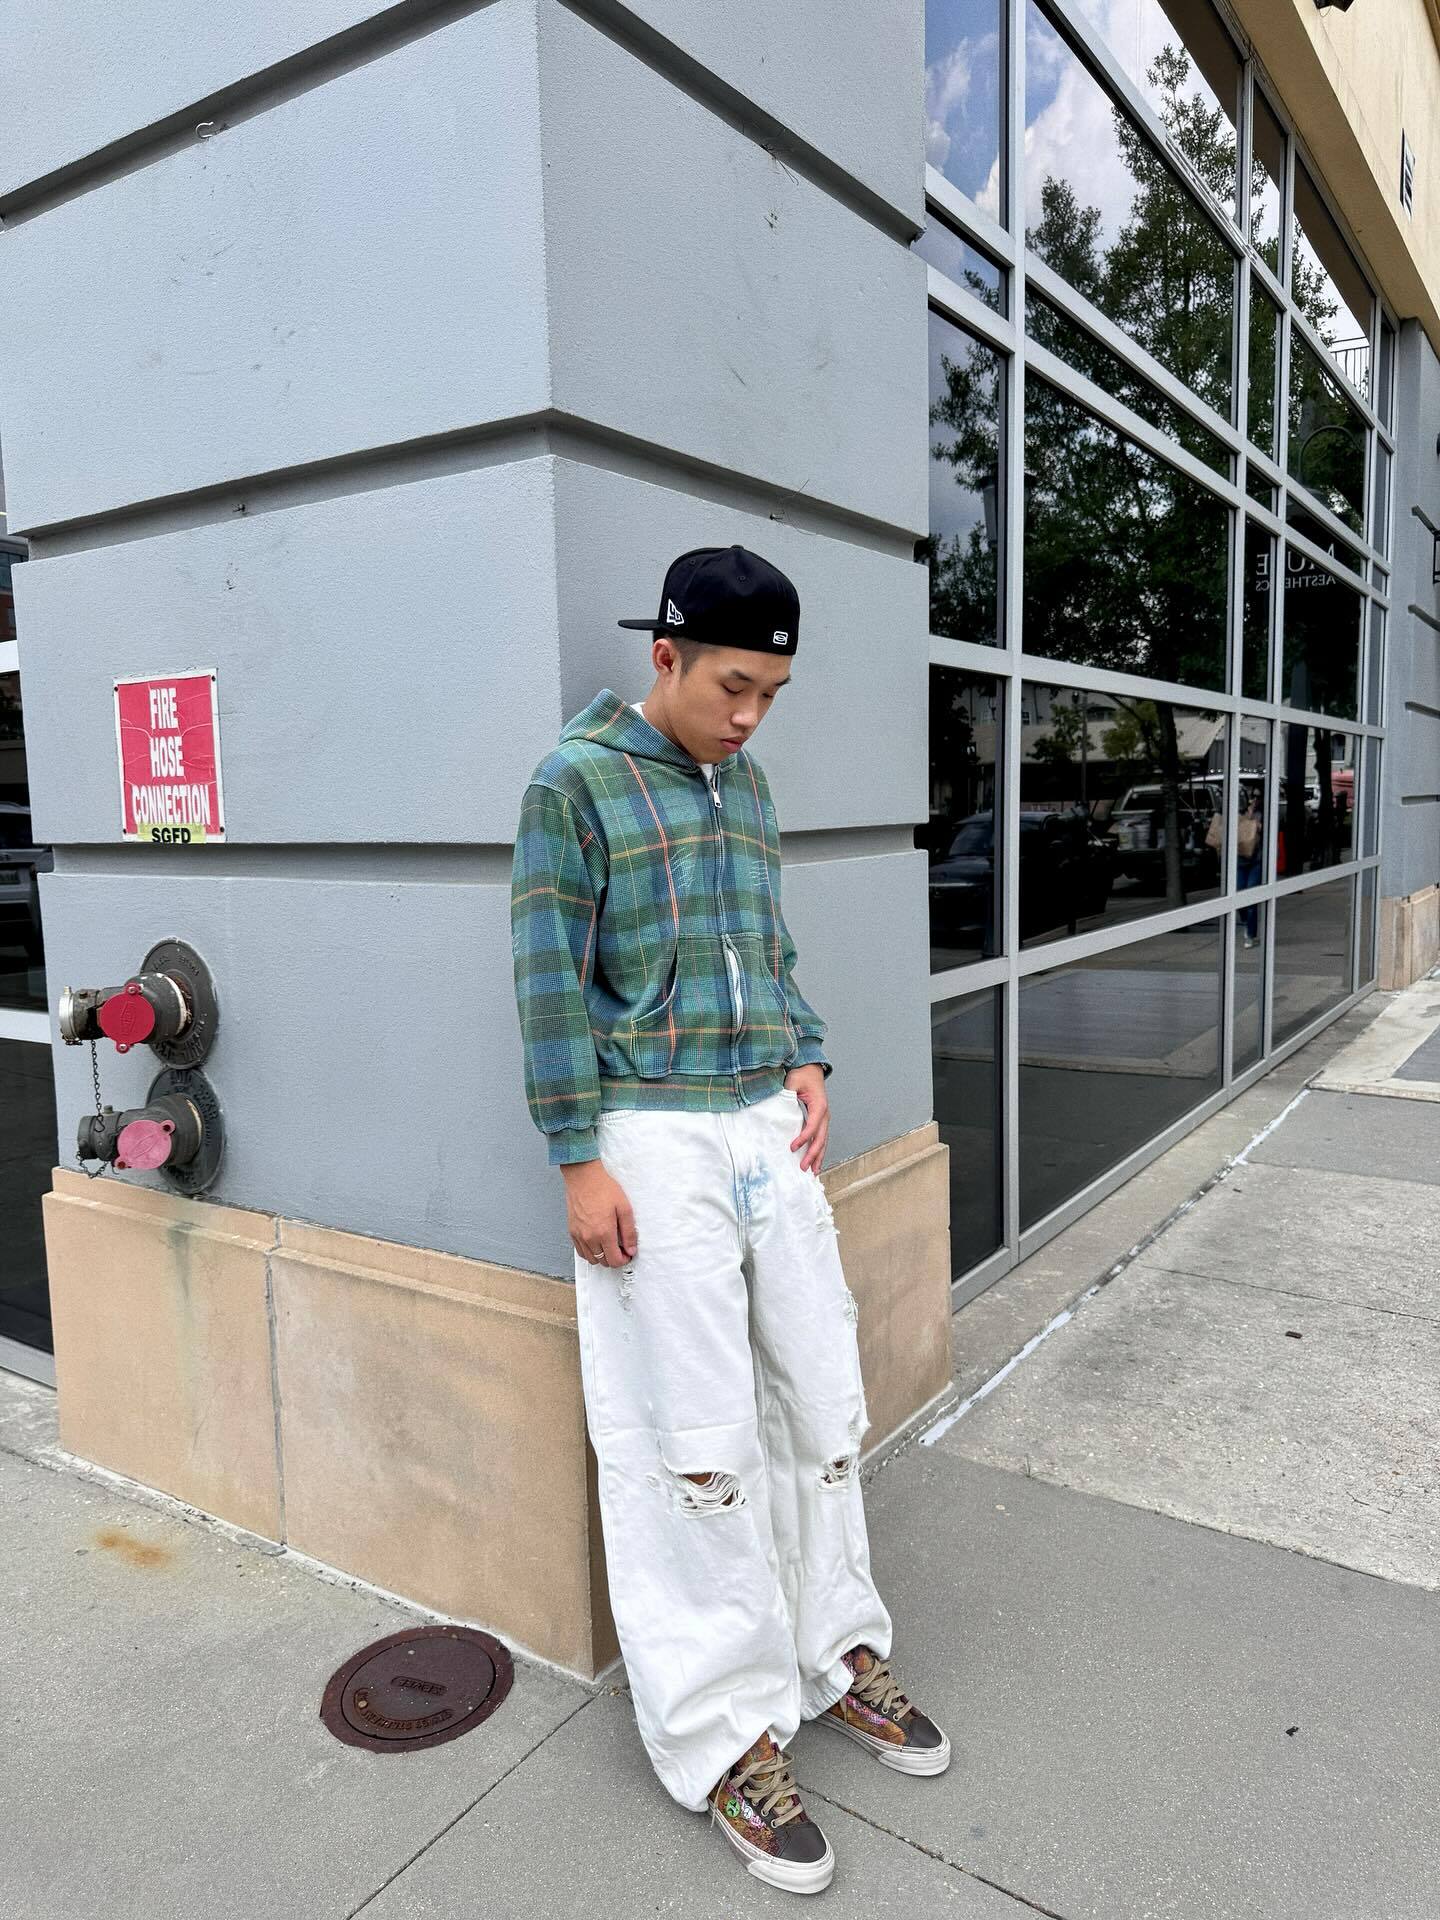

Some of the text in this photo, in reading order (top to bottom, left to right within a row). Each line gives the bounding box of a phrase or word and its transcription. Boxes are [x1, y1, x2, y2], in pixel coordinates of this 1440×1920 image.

[150, 687, 179, 729] FIRE
[150, 736, 185, 777] HOSE
[131, 784, 211, 825] CONNECTION
[151, 827, 191, 844] SGFD
